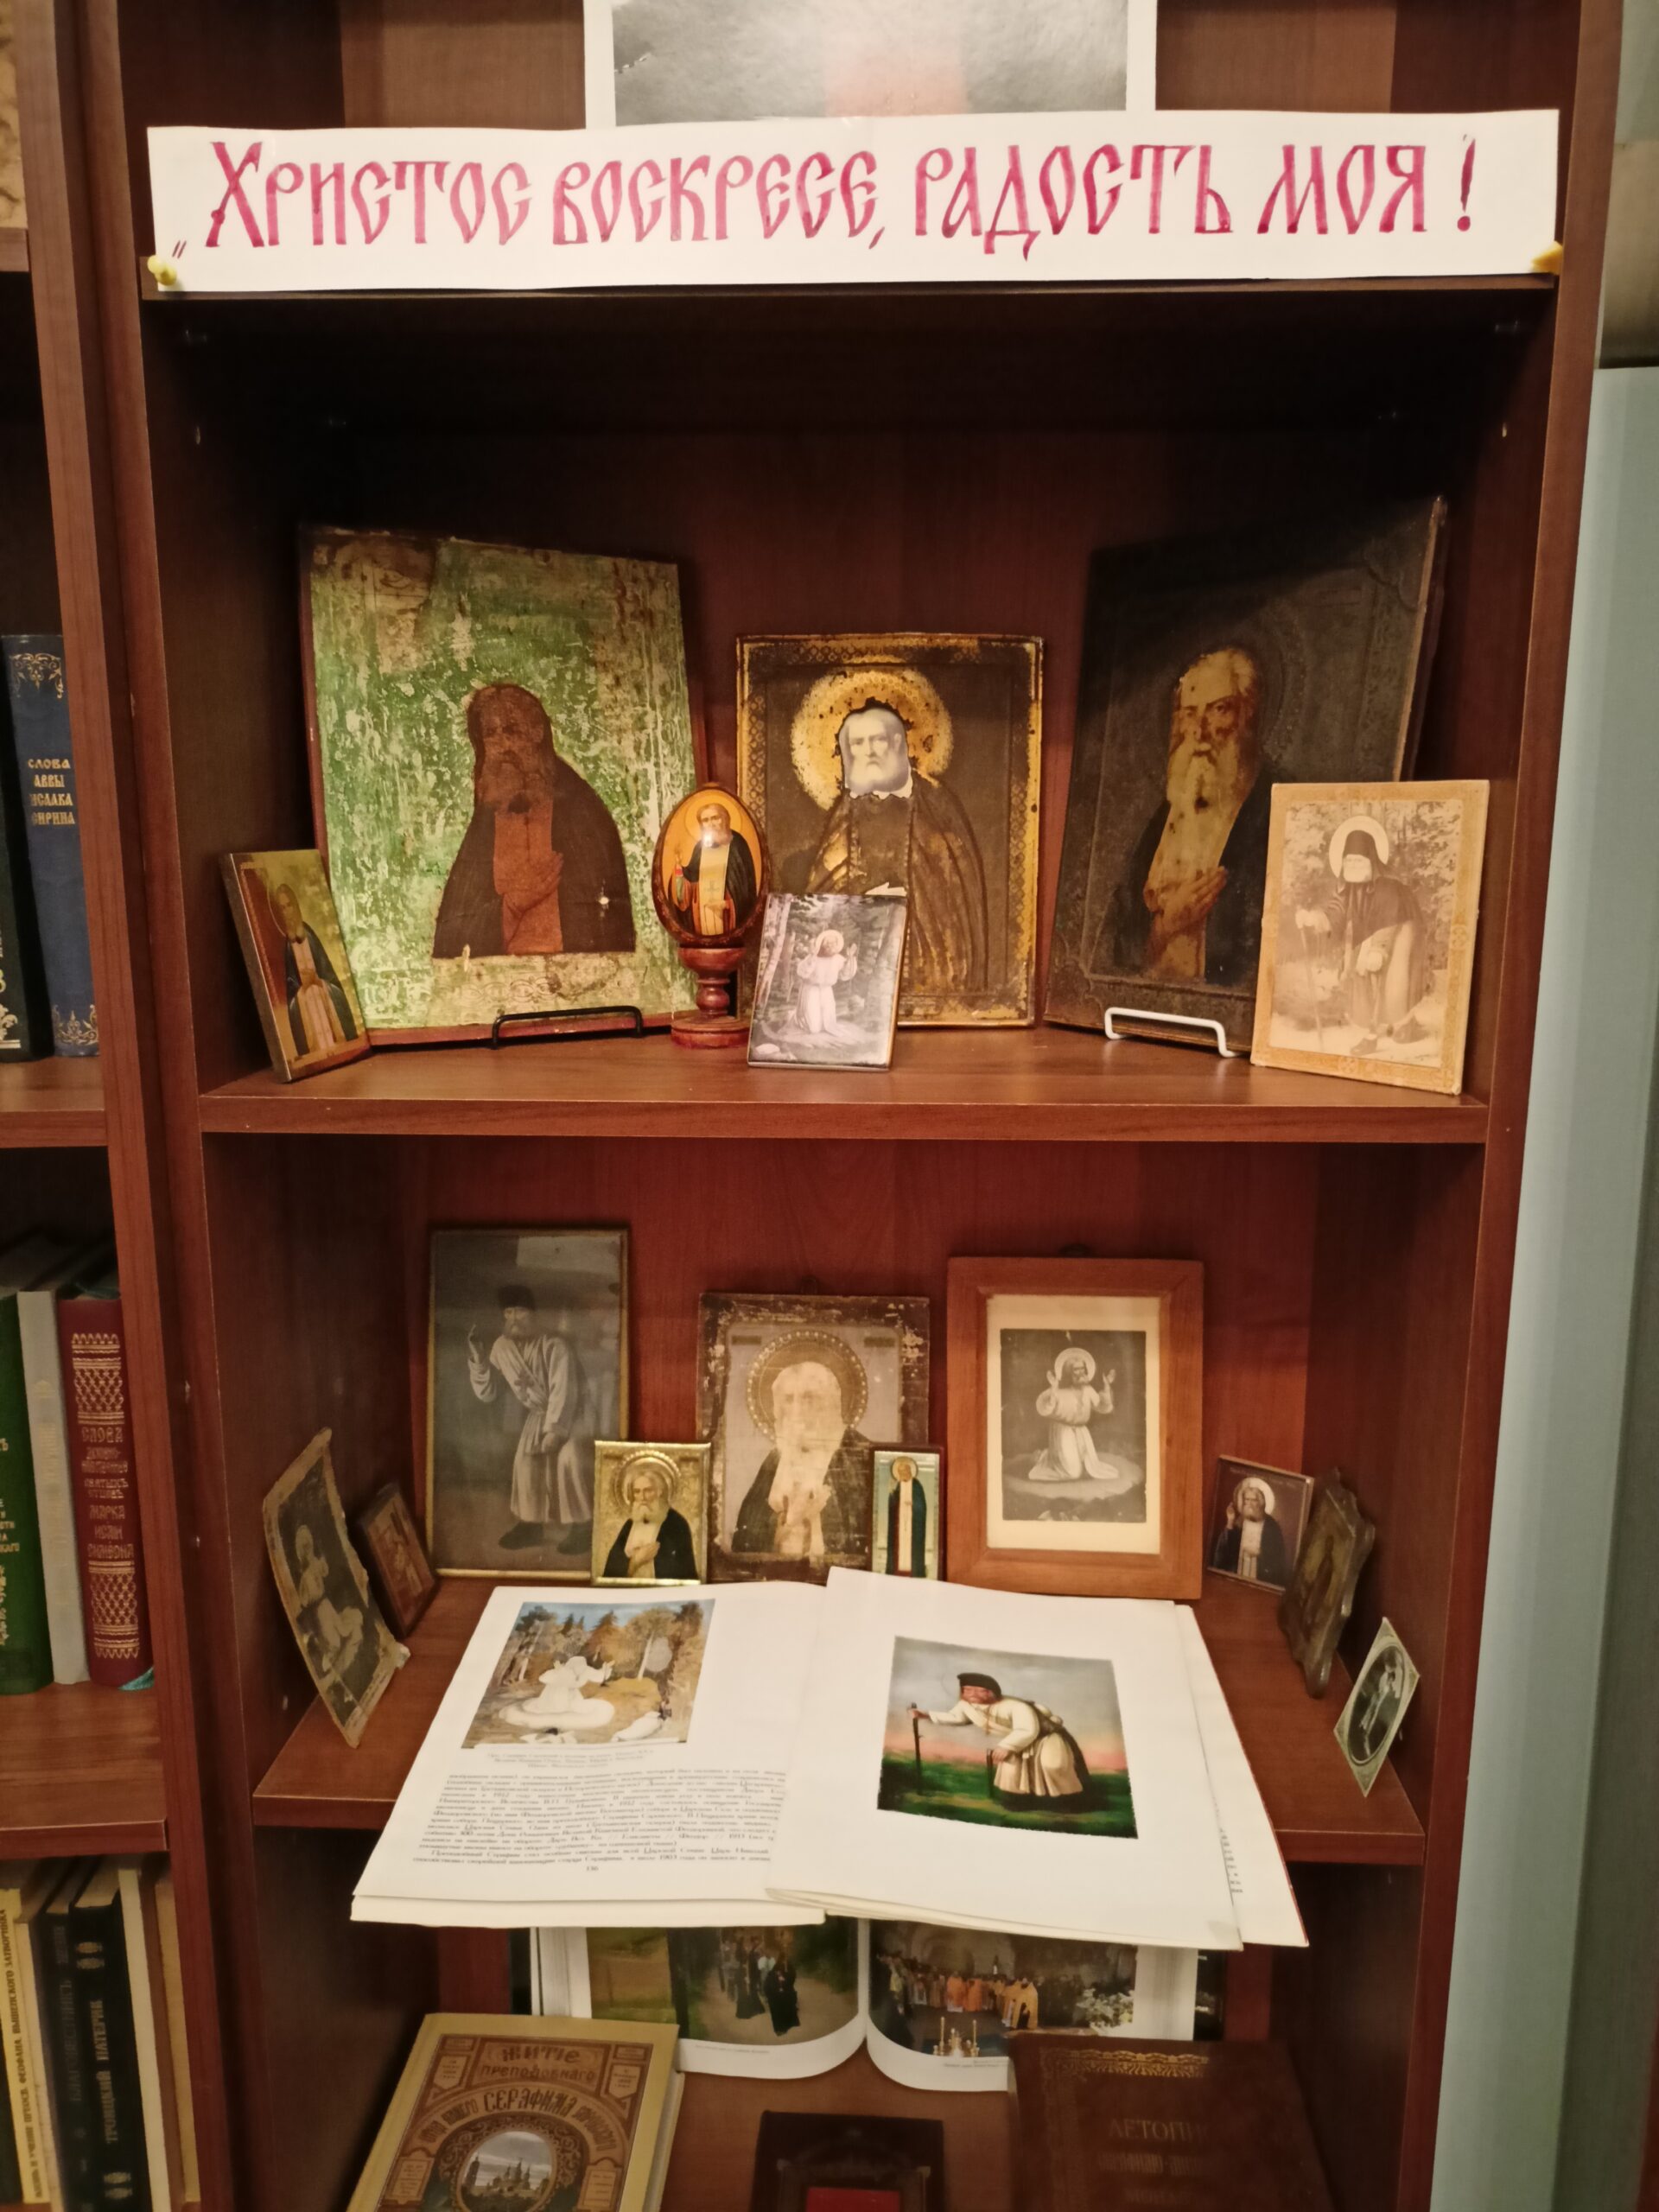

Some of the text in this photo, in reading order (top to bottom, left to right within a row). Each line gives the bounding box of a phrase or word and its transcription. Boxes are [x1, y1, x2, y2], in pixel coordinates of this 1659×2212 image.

[914, 143, 1233, 261] РАДОСТЬ
[28, 758, 71, 769] СЛОВА
[34, 774, 65, 787] АВВЫ
